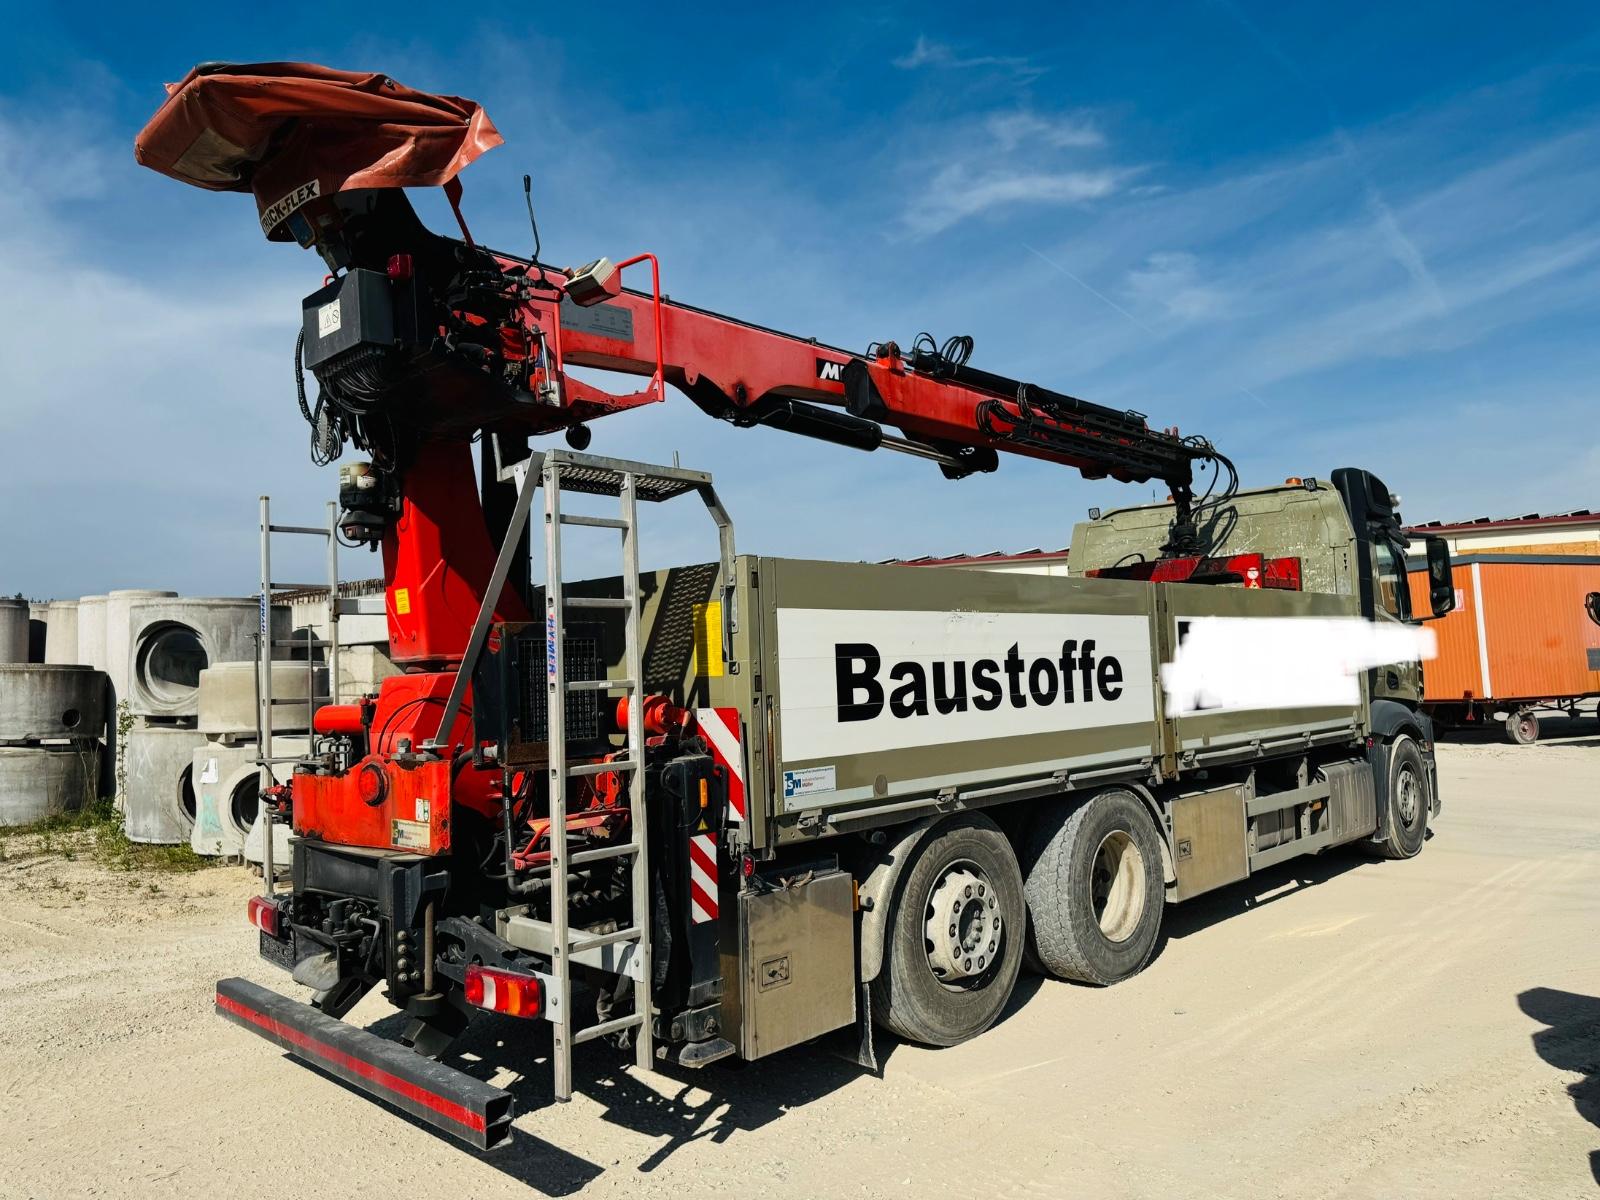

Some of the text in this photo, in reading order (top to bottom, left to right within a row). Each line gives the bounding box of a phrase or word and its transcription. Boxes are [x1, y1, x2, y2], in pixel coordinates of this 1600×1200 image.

[820, 361, 845, 381] M
[547, 617, 557, 676] HYMER
[834, 639, 1123, 723] Baustoffe
